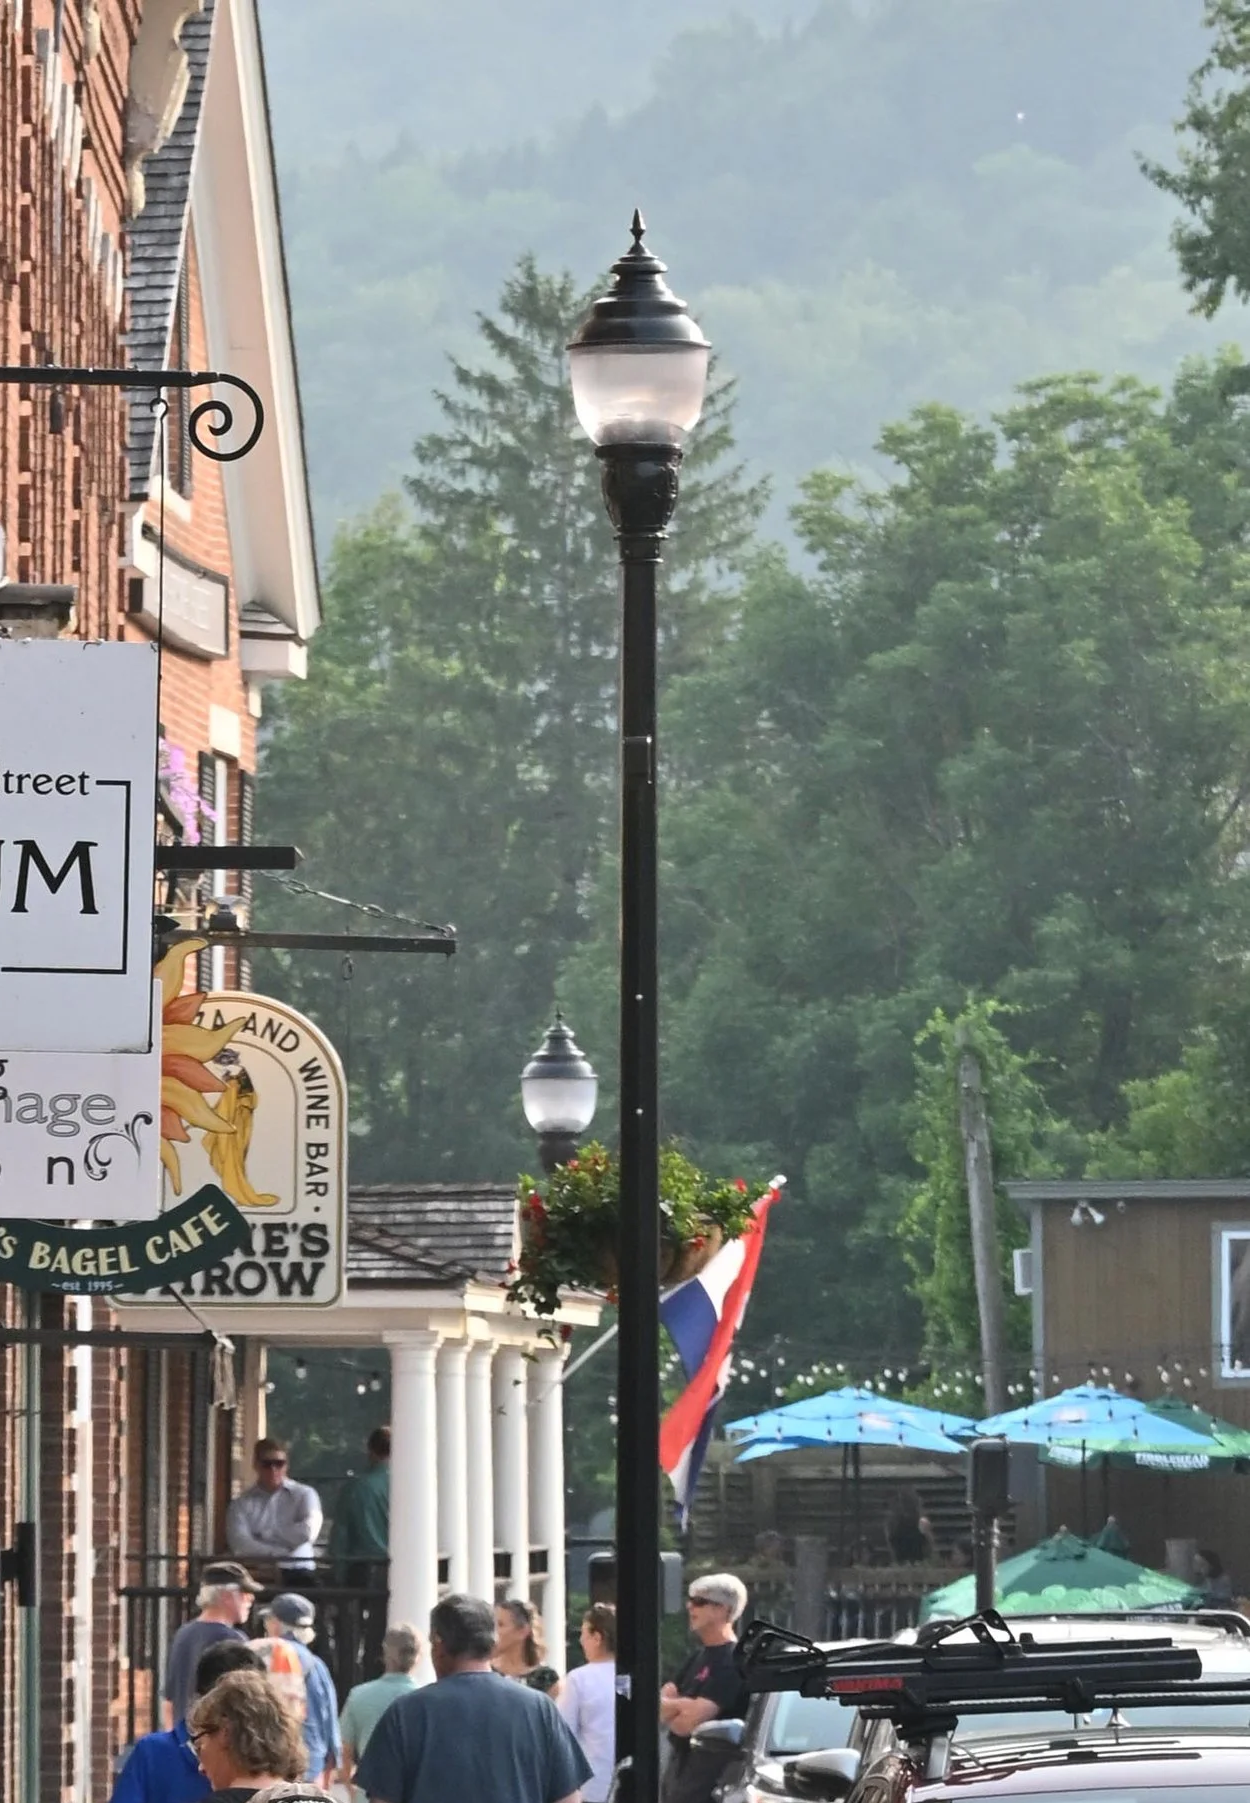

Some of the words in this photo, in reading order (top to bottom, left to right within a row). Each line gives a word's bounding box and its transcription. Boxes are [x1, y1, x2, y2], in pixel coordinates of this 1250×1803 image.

[241, 1012, 301, 1054] AND
[297, 1056, 331, 1131] WINE
[305, 1142, 330, 1198] BAR
[28, 1241, 140, 1277] BAGEL
[145, 1203, 232, 1266] CAFE
